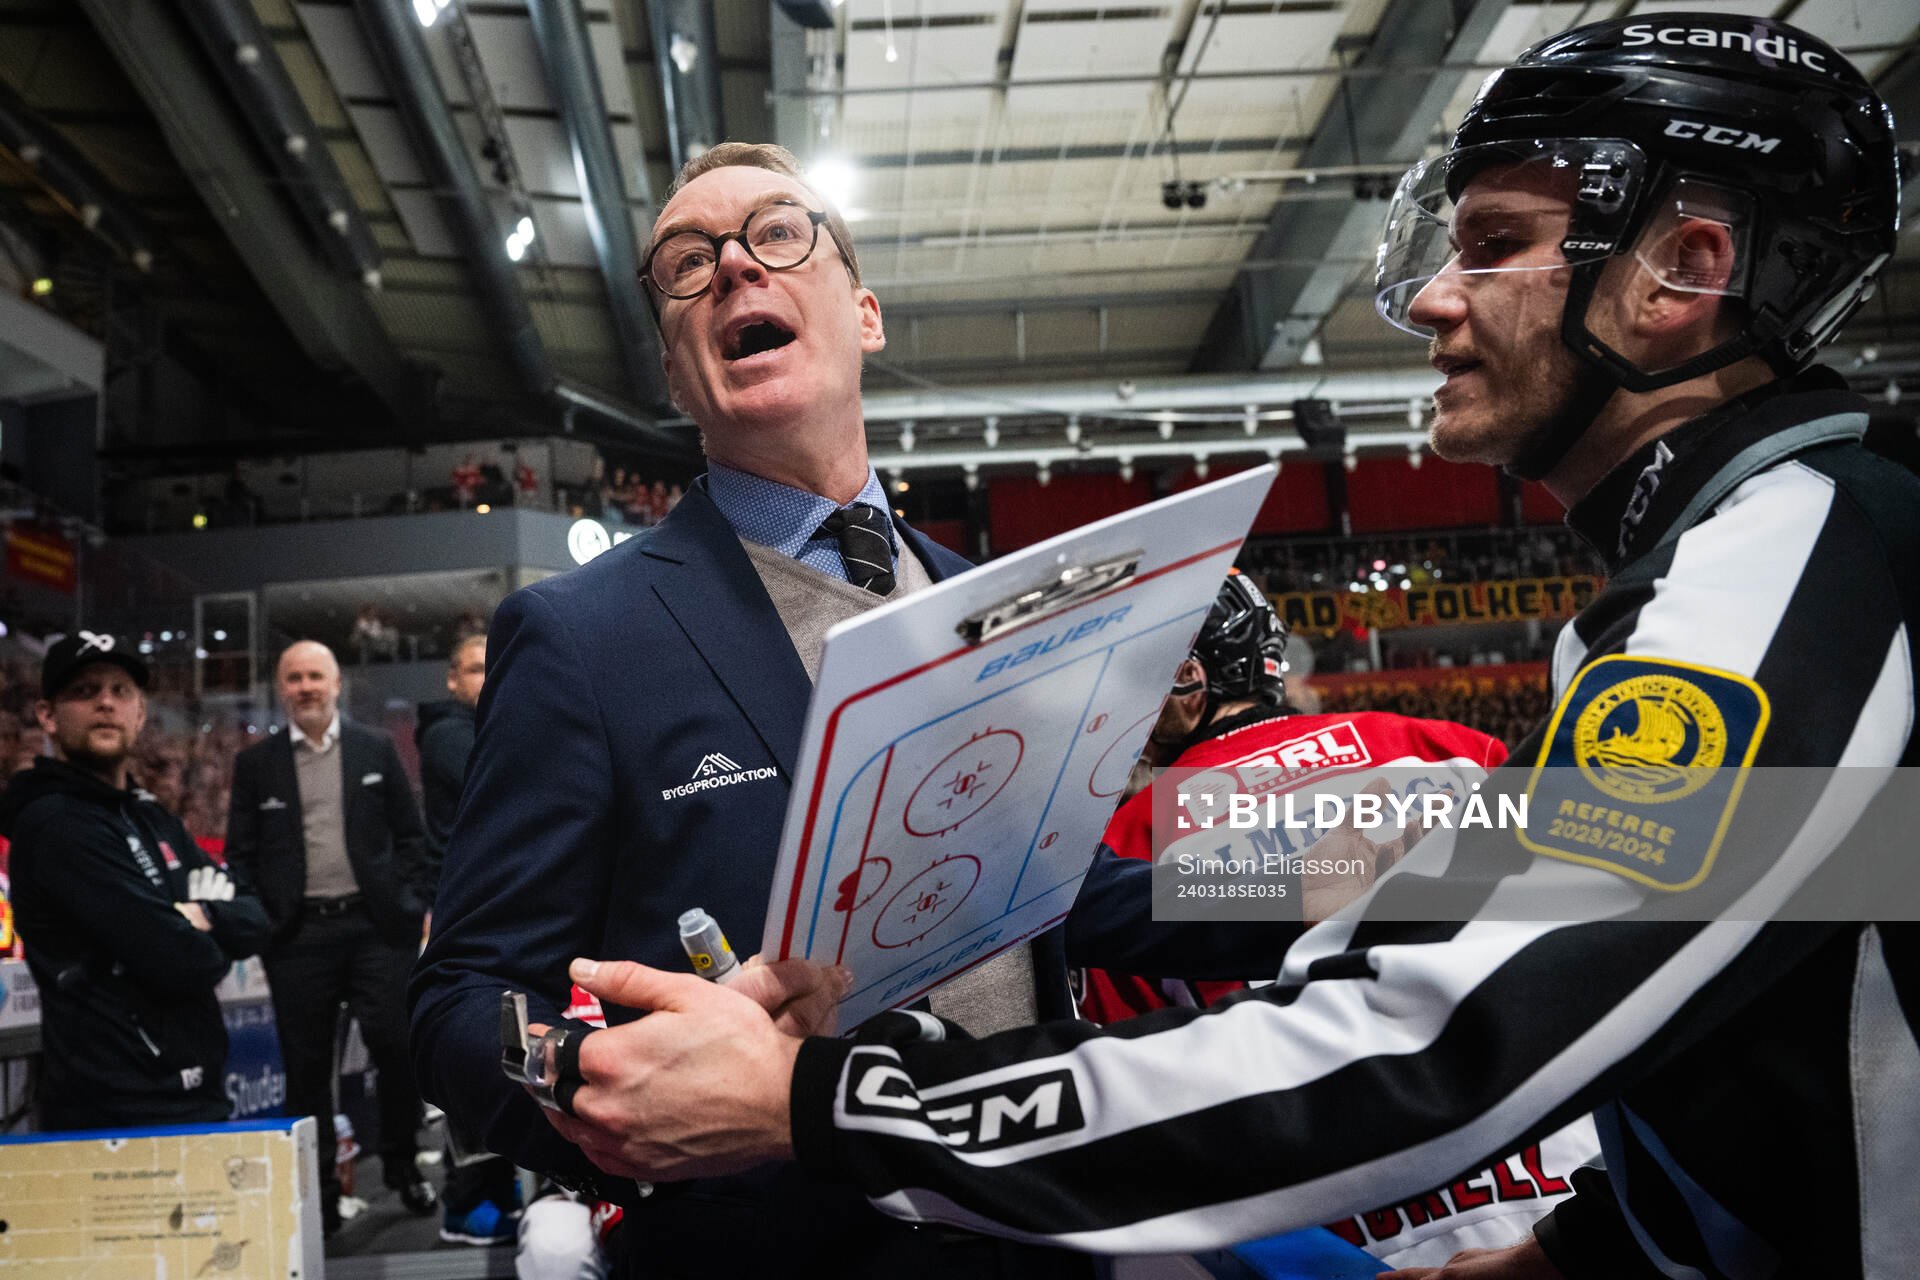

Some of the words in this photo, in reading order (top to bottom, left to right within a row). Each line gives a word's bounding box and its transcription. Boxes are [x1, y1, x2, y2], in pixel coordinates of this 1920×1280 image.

[1622, 23, 1827, 73] Scandic
[1664, 119, 1782, 155] CCM
[1563, 241, 1612, 251] CCM
[1271, 597, 1337, 627] AD
[976, 604, 1133, 683] BAUER
[702, 763, 718, 776] SL
[1236, 732, 1357, 789] BRL
[661, 766, 778, 801] BYGGPRODUKTION
[1558, 799, 1676, 846] REFEREE
[855, 1065, 1063, 1146] CCM
